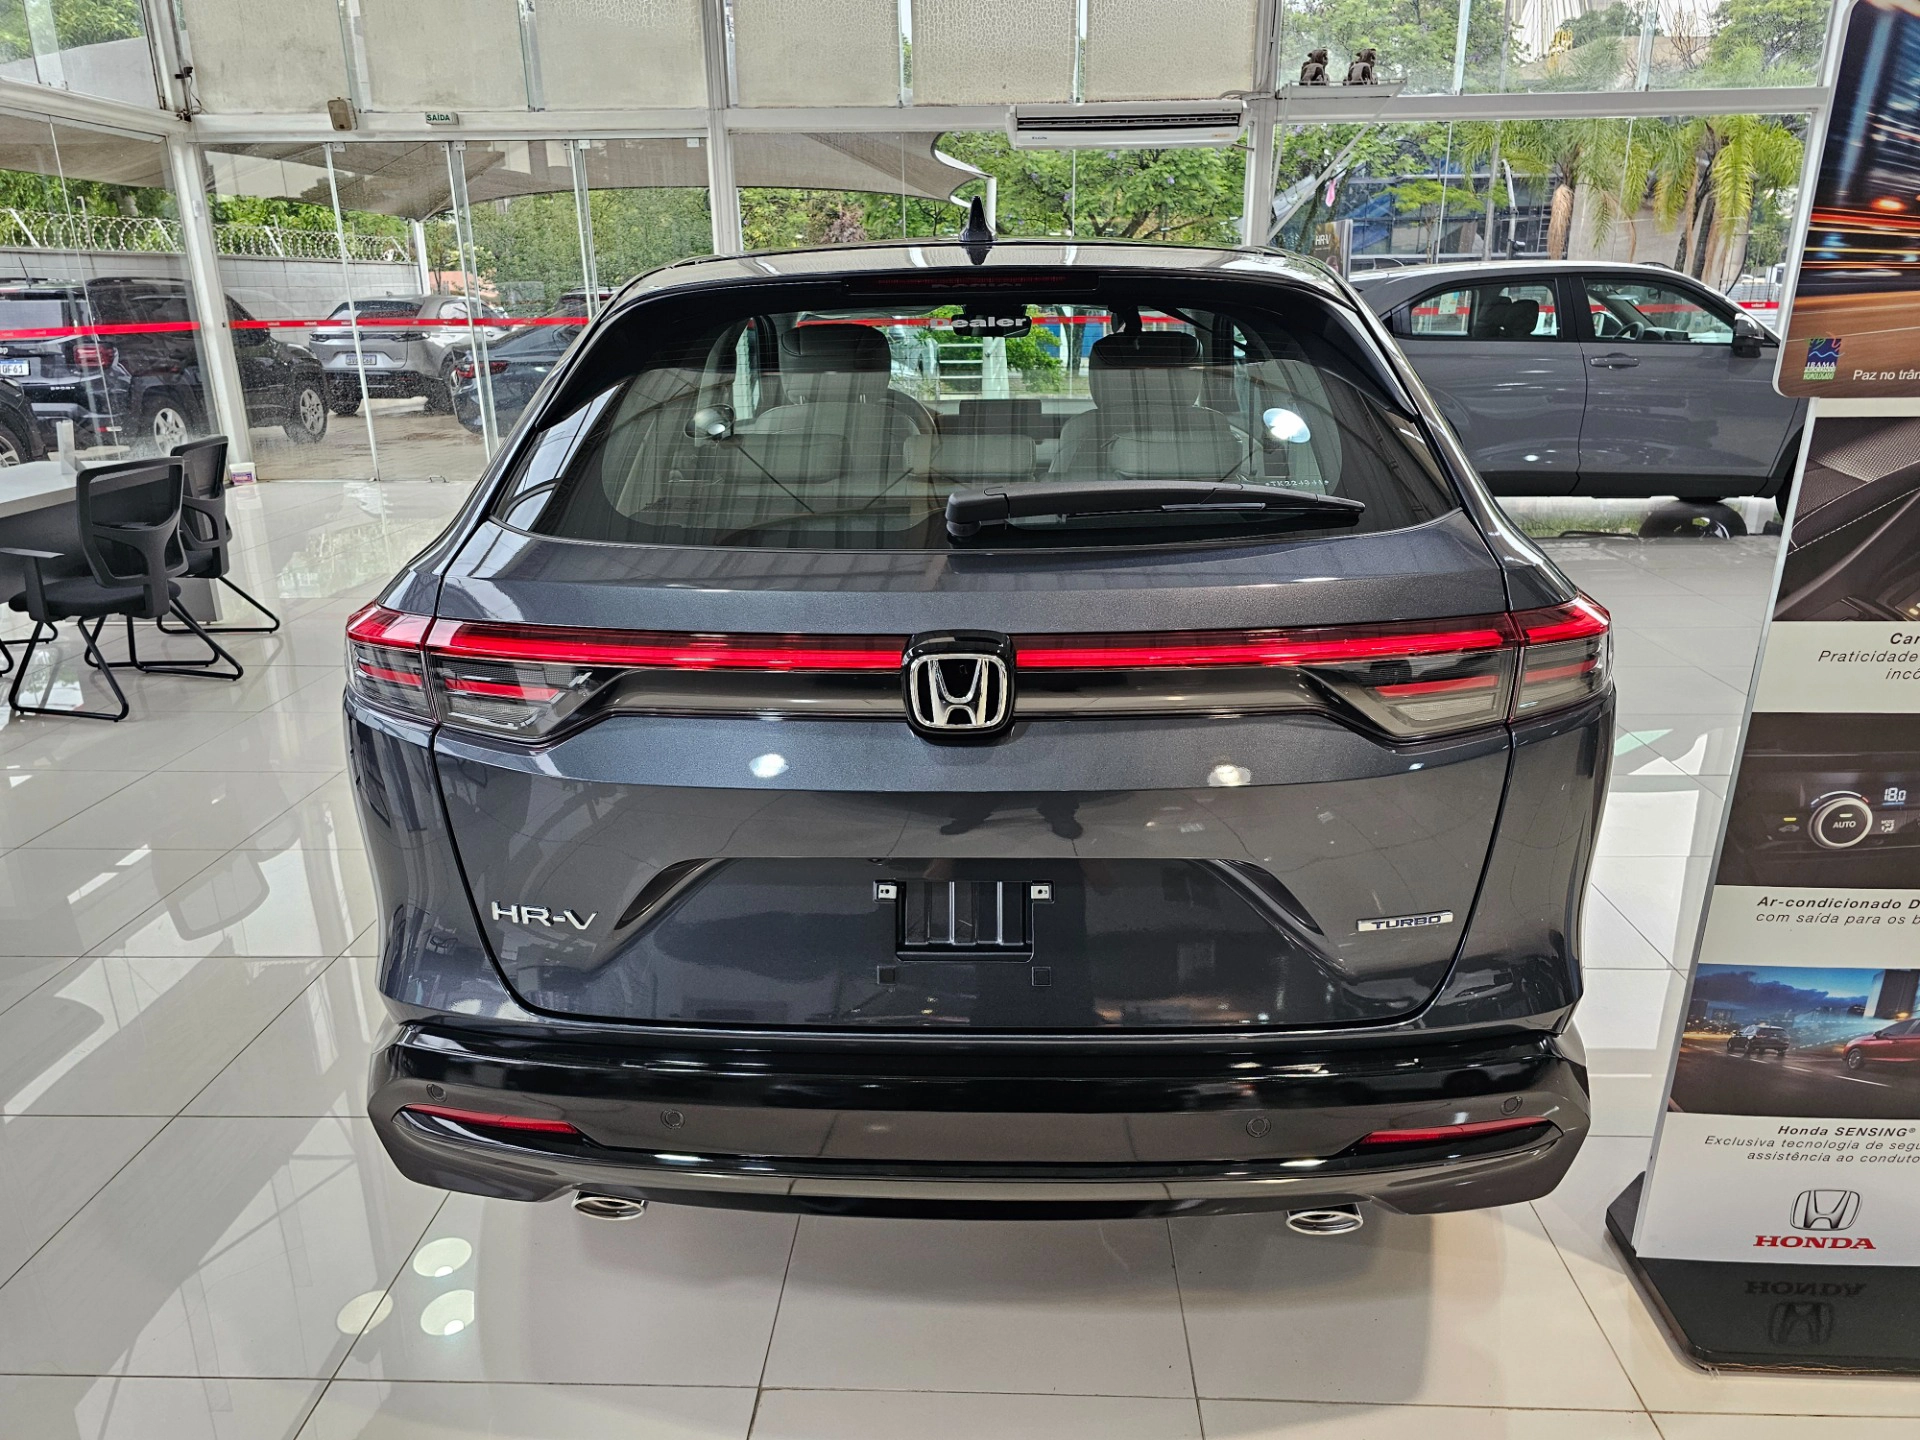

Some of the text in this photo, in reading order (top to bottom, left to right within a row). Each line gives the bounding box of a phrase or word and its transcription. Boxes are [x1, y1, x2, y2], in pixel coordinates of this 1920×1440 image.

[426, 112, 450, 121] SAÍDA
[930, 316, 1027, 328] Dealer
[1853, 369, 1878, 380] Paz
[1880, 371, 1896, 380] no
[1818, 650, 1918, 662] Praticidade
[1832, 820, 1857, 829] AUTO
[1756, 896, 1902, 909] Ar-condicionado
[491, 900, 598, 930] HR-V
[1756, 913, 1790, 923] com
[1796, 912, 1839, 924] saída
[1844, 914, 1881, 926] para
[1887, 915, 1906, 925] os
[1371, 915, 1441, 929] TURBO
[1777, 1125, 1829, 1136] Honda
[1704, 1135, 1775, 1148] Exclusiva
[1781, 1138, 1860, 1151] tecnologia
[1865, 1140, 1883, 1150] de
[1747, 1151, 1920, 1164] assistência ao conduto
[1753, 1235, 1876, 1249] HONDA
